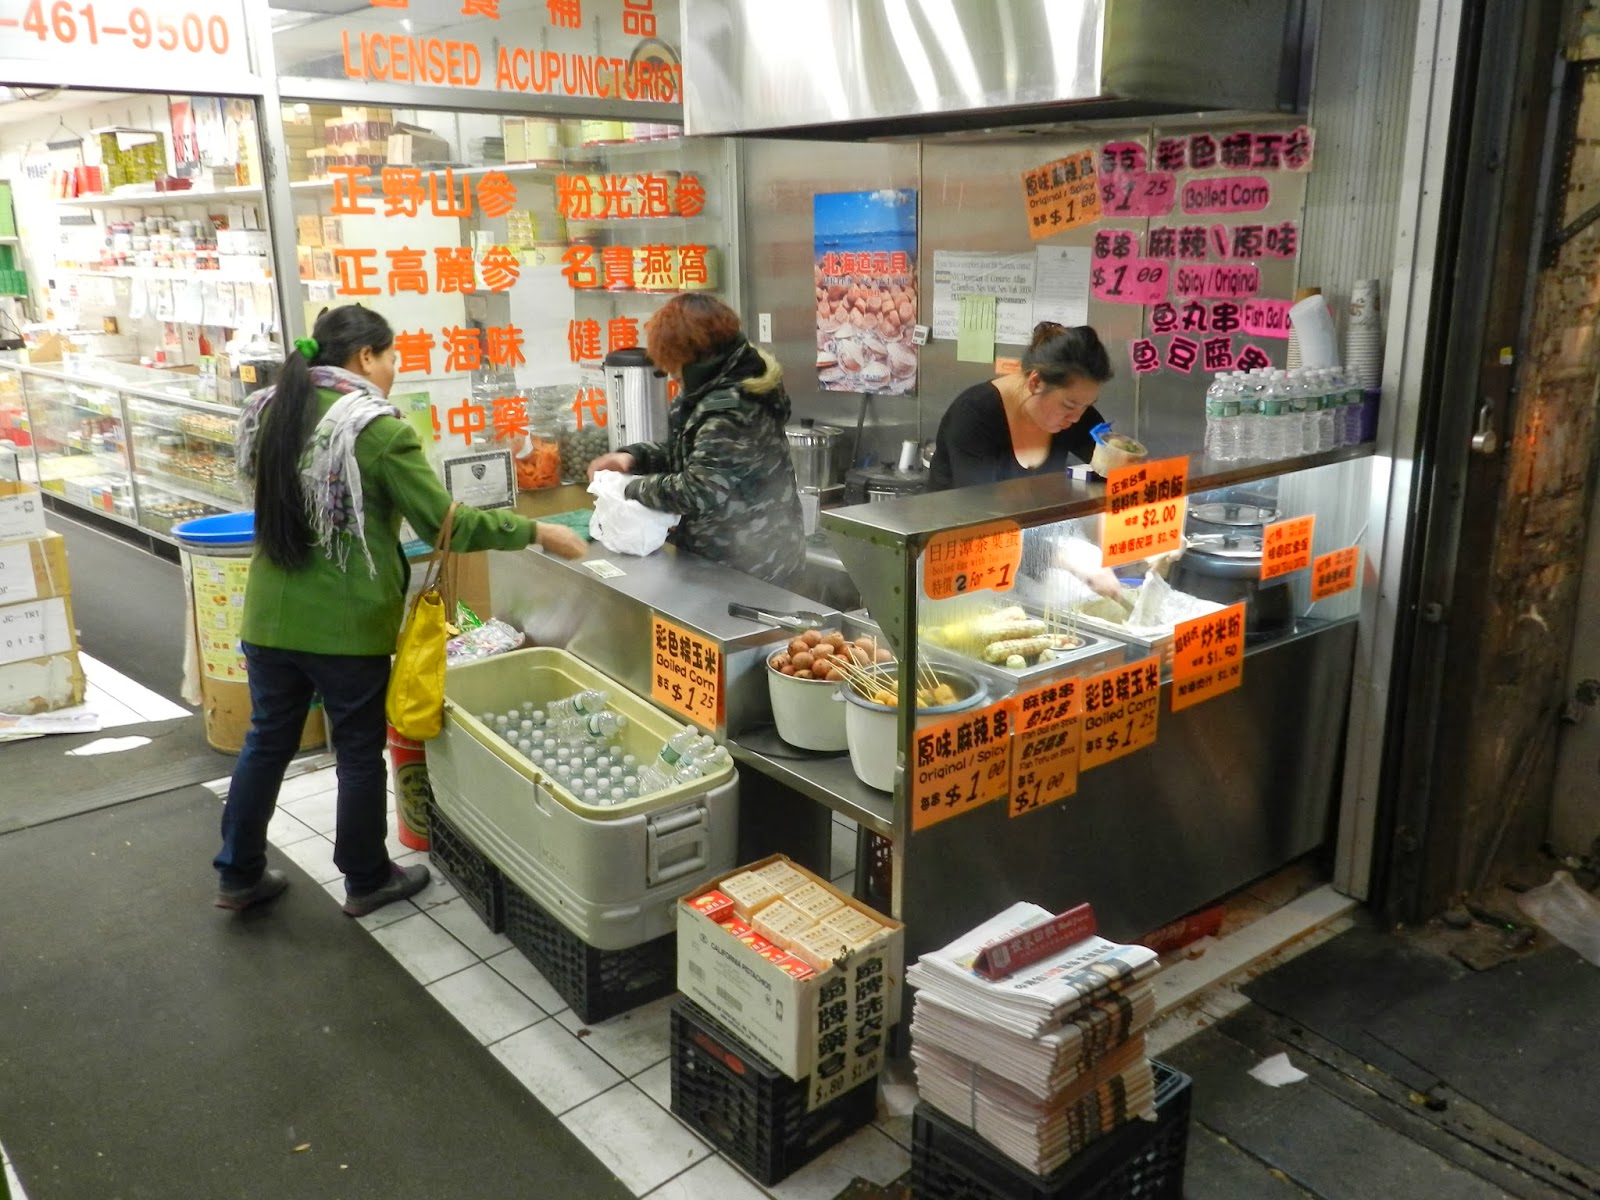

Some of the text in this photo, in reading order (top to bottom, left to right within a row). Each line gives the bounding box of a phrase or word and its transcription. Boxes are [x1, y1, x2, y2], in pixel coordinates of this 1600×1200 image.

[342, 30, 683, 105] LICENSED ACUPUNCTURIST
[328, 166, 518, 218] 正野山參
[556, 174, 706, 218] 粉光泡參
[1029, 190, 1063, 208] Original
[1184, 183, 1269, 209] Boiled Corn
[334, 245, 520, 296] 正高麗參
[561, 243, 708, 291] 名貴燕窩
[823, 252, 908, 275] 北海道元貝
[1177, 269, 1205, 297] Spicy
[1214, 267, 1258, 295] Original
[1244, 304, 1264, 326] Fish
[1266, 308, 1284, 330] Ball
[431, 396, 530, 446] 中藥
[955, 574, 967, 591] 2
[656, 624, 717, 675] 彩色糯玉米
[656, 653, 716, 693] Boiled Corn
[1086, 664, 1158, 712] 彩色糯玉米
[1086, 696, 1157, 731] Boiled Corn
[919, 757, 967, 784] Original
[977, 744, 1008, 763] Spicy
[711, 942, 742, 968] CALIFORNIA
